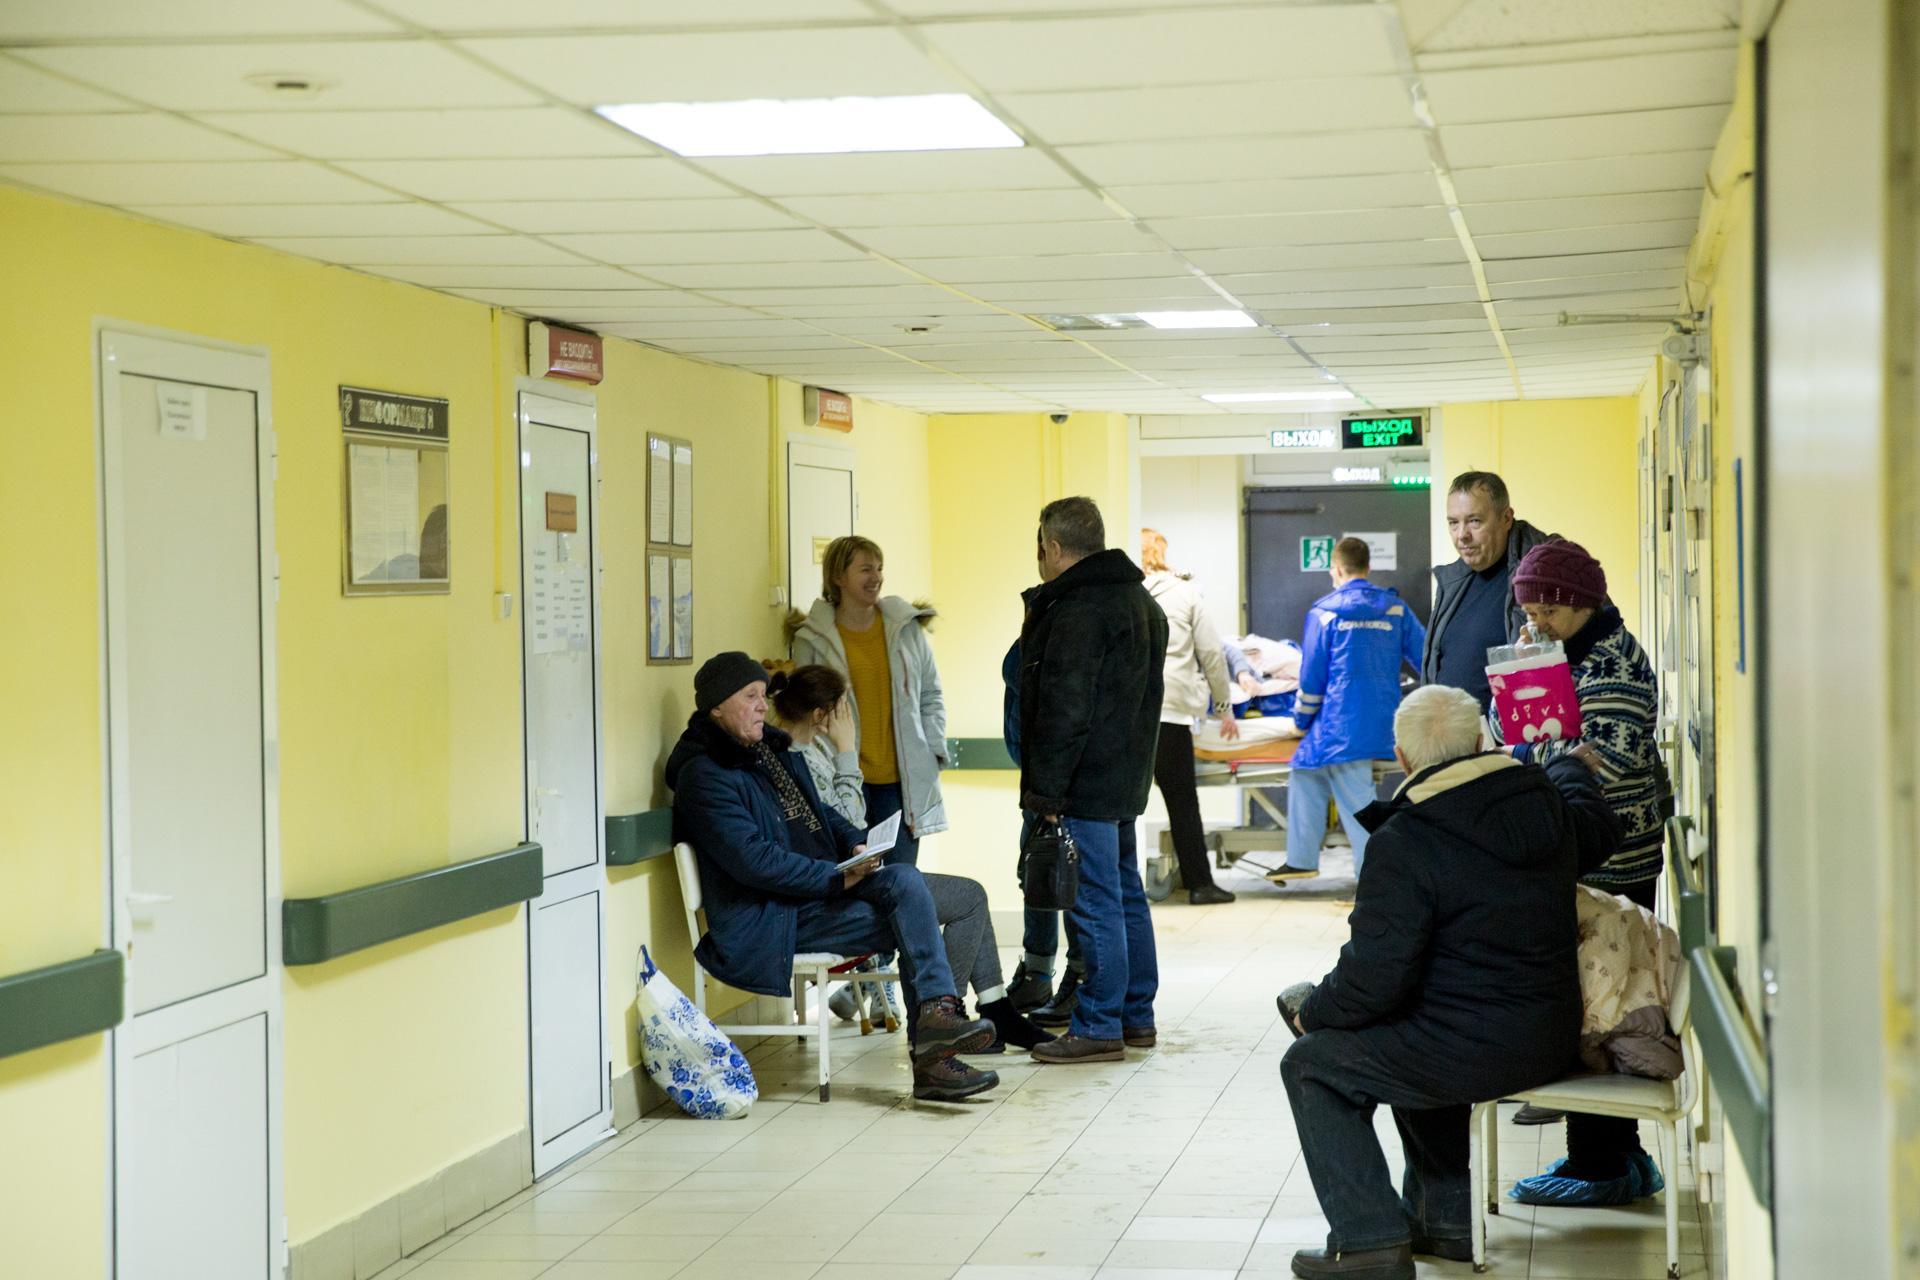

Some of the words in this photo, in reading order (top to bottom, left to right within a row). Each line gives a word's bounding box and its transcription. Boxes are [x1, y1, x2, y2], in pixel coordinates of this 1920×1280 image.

[359, 398, 434, 432] ИНФОРМАЦИЯ
[1351, 419, 1413, 435] ВЫХОД
[1273, 430, 1334, 447] ВЫХОД
[1362, 432, 1401, 447] EXIT
